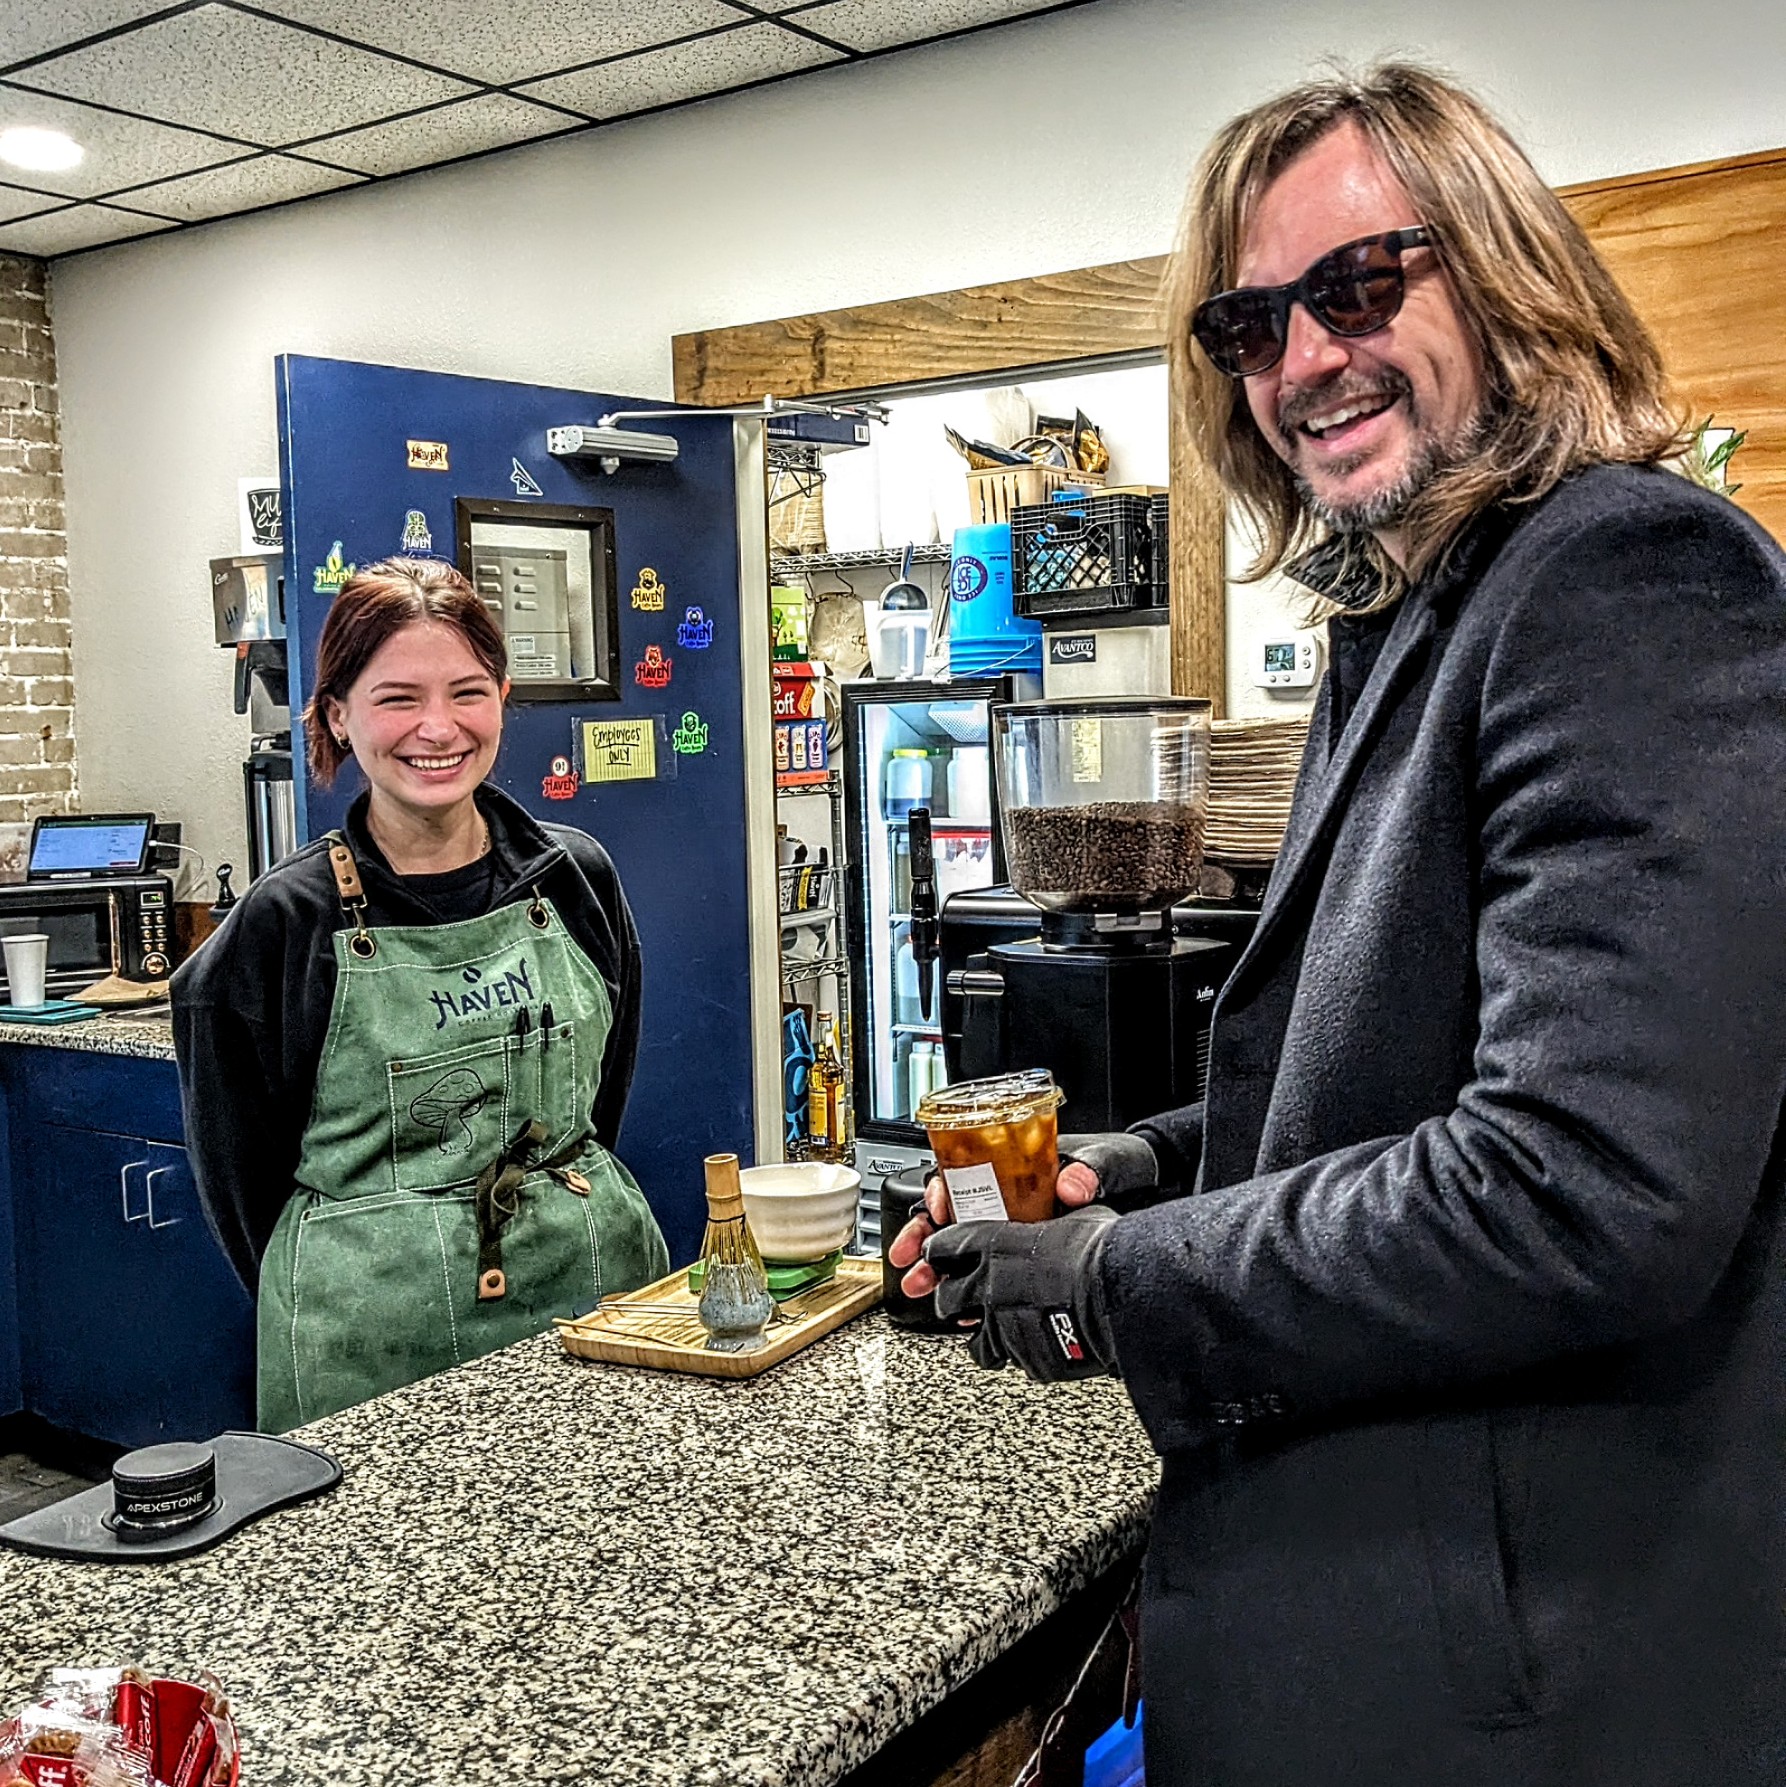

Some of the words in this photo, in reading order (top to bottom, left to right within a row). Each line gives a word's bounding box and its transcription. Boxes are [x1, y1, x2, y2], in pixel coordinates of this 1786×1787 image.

[402, 533, 432, 551] HAVEN
[316, 564, 354, 587] HAVEN
[633, 587, 663, 607] HAVEN
[679, 621, 711, 643] HAVEN
[1052, 640, 1094, 657] AVANTCO
[637, 659, 670, 682] HAVEN
[675, 726, 706, 749] HAVEN
[608, 747, 630, 764] ONLY
[544, 772, 578, 796] HAVEN
[429, 957, 535, 1030] HAVEN
[127, 1492, 203, 1512] APEXSTONE
